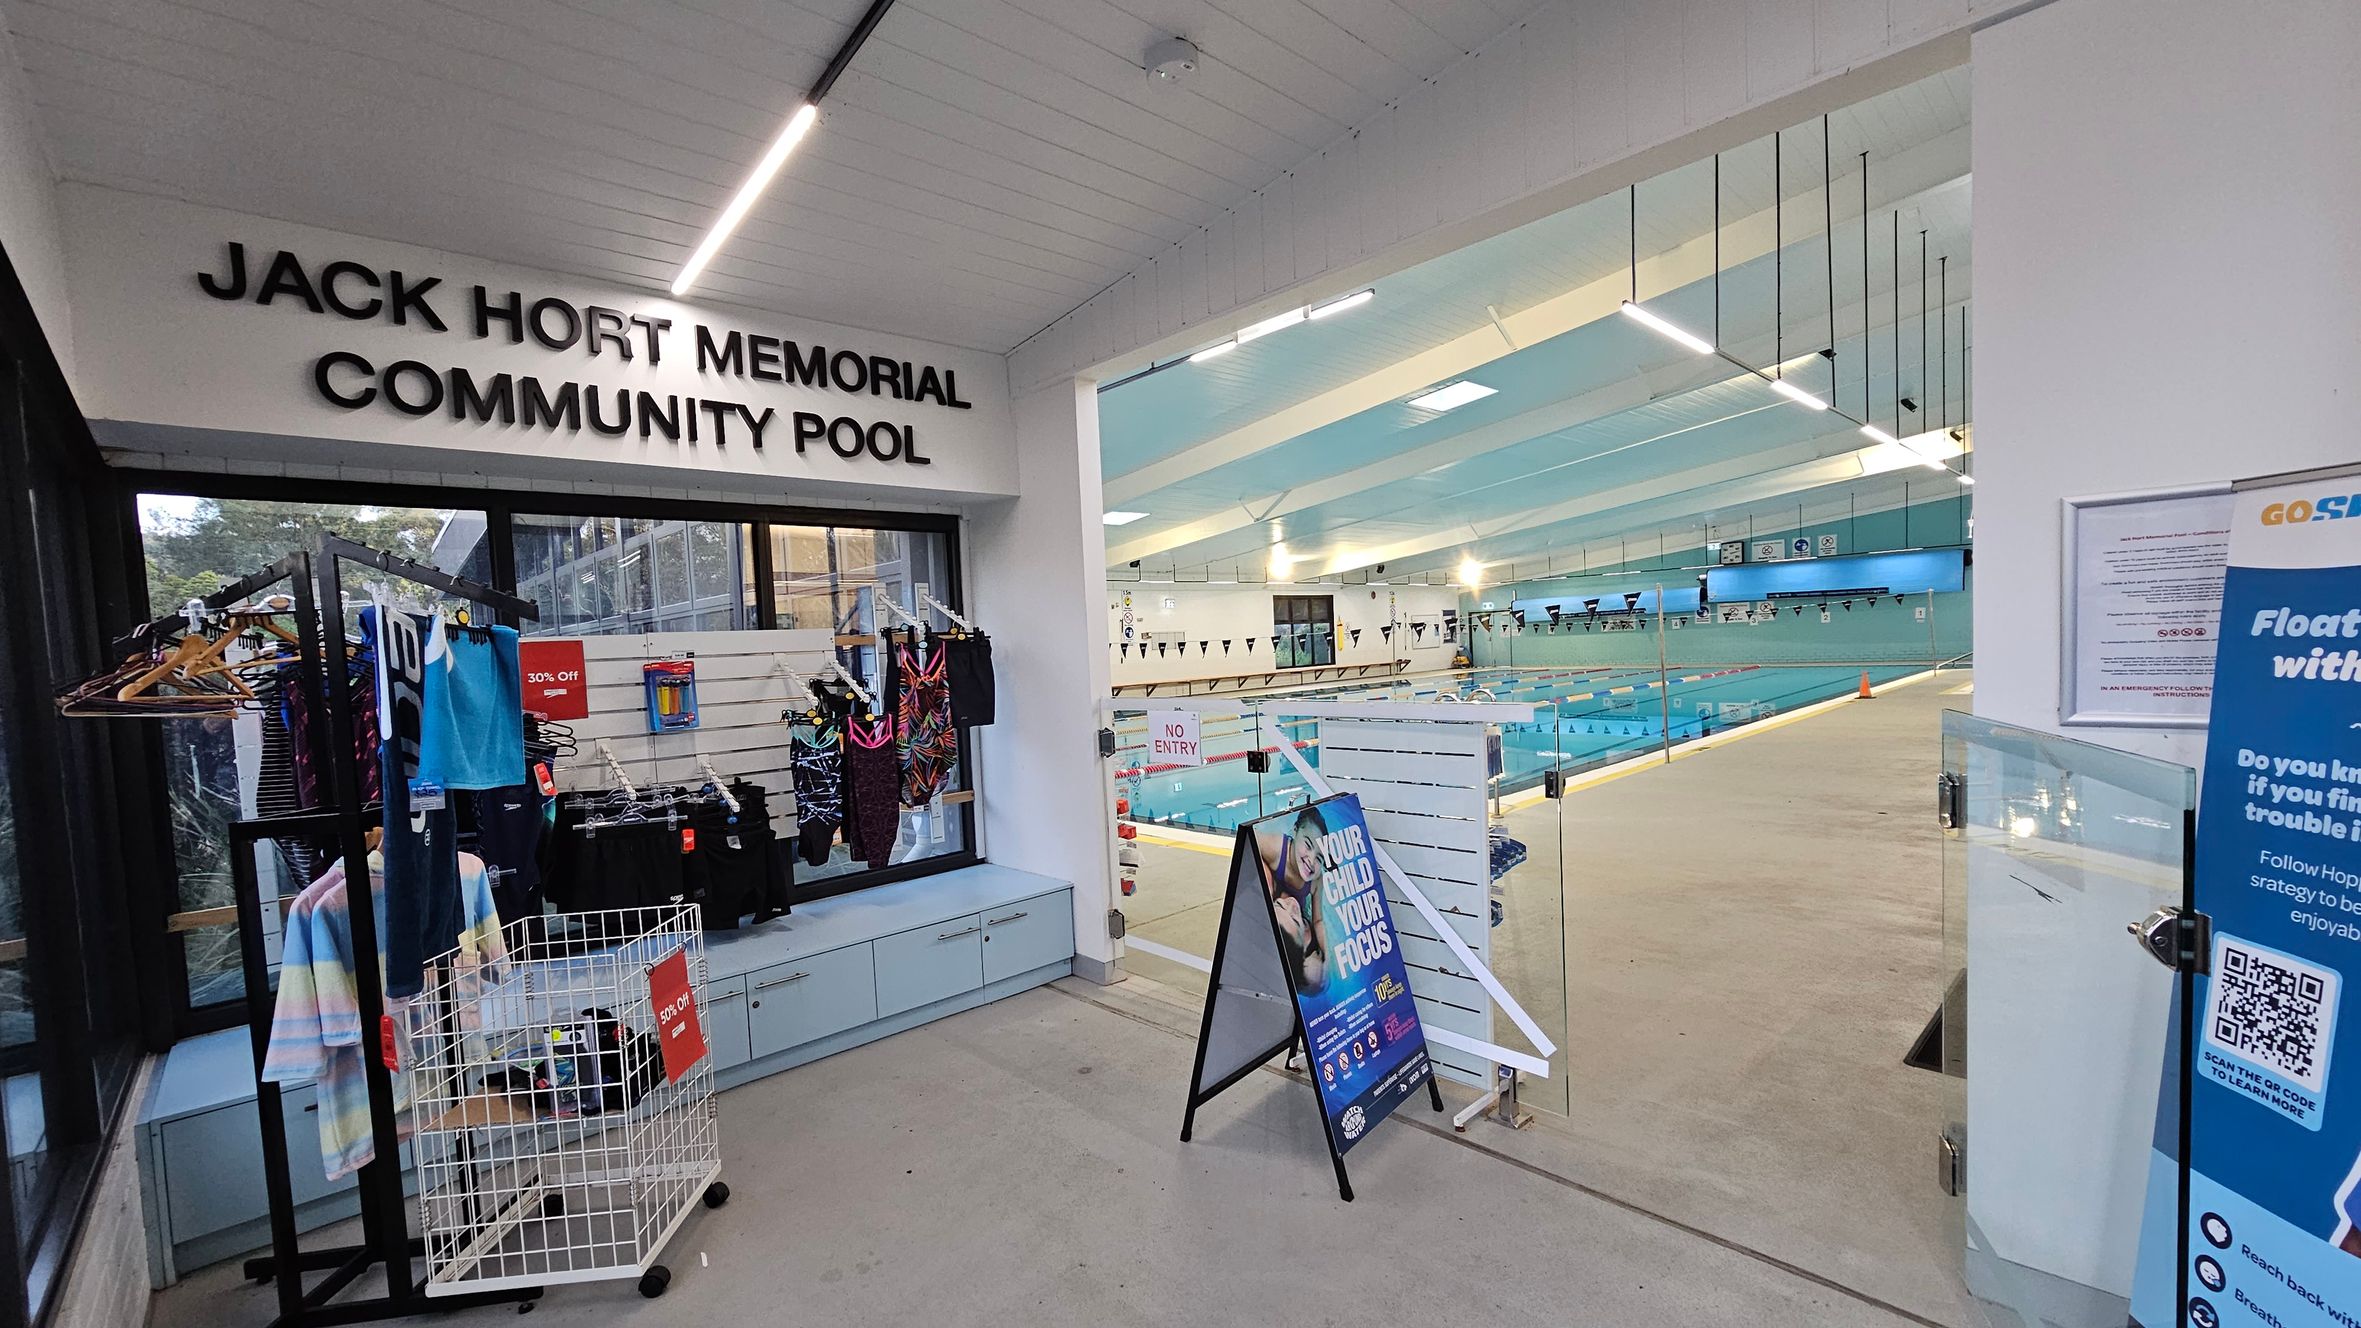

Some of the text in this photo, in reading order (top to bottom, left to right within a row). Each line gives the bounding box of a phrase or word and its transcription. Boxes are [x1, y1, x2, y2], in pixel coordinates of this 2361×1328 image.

[198, 241, 972, 410] JACK HORT MEMORIAL
[314, 351, 931, 465] COMMUNITY POOL
[2251, 606, 2361, 638] Float
[527, 670, 579, 683] 30% Off
[1155, 739, 1197, 756] ENTRY
[1165, 724, 1184, 738] NO
[2237, 748, 2270, 771] Do
[2273, 757, 2327, 779] you
[2247, 773, 2269, 796] if
[2270, 783, 2323, 807] you
[2244, 801, 2361, 842] trouble i
[1316, 824, 1367, 869] YOUR
[1322, 857, 1375, 906] CHILD
[2250, 874, 2316, 905] srategy
[2319, 890, 2337, 907] to
[2260, 850, 2361, 893] Follow Hop
[1335, 889, 1385, 936] YOUR
[2290, 910, 2361, 941] enjoyab
[1334, 920, 1392, 980] FOCUS
[660, 991, 690, 1025] 50% Off
[2204, 1051, 2316, 1112] SCAN THE QR CODE
[2211, 1066, 2305, 1119] TO LEARN MORE
[1343, 1116, 1367, 1140] WATER
[2241, 1243, 2284, 1282] Reach
[2287, 1275, 2325, 1311] back
[2234, 1288, 2287, 1328] Breath
